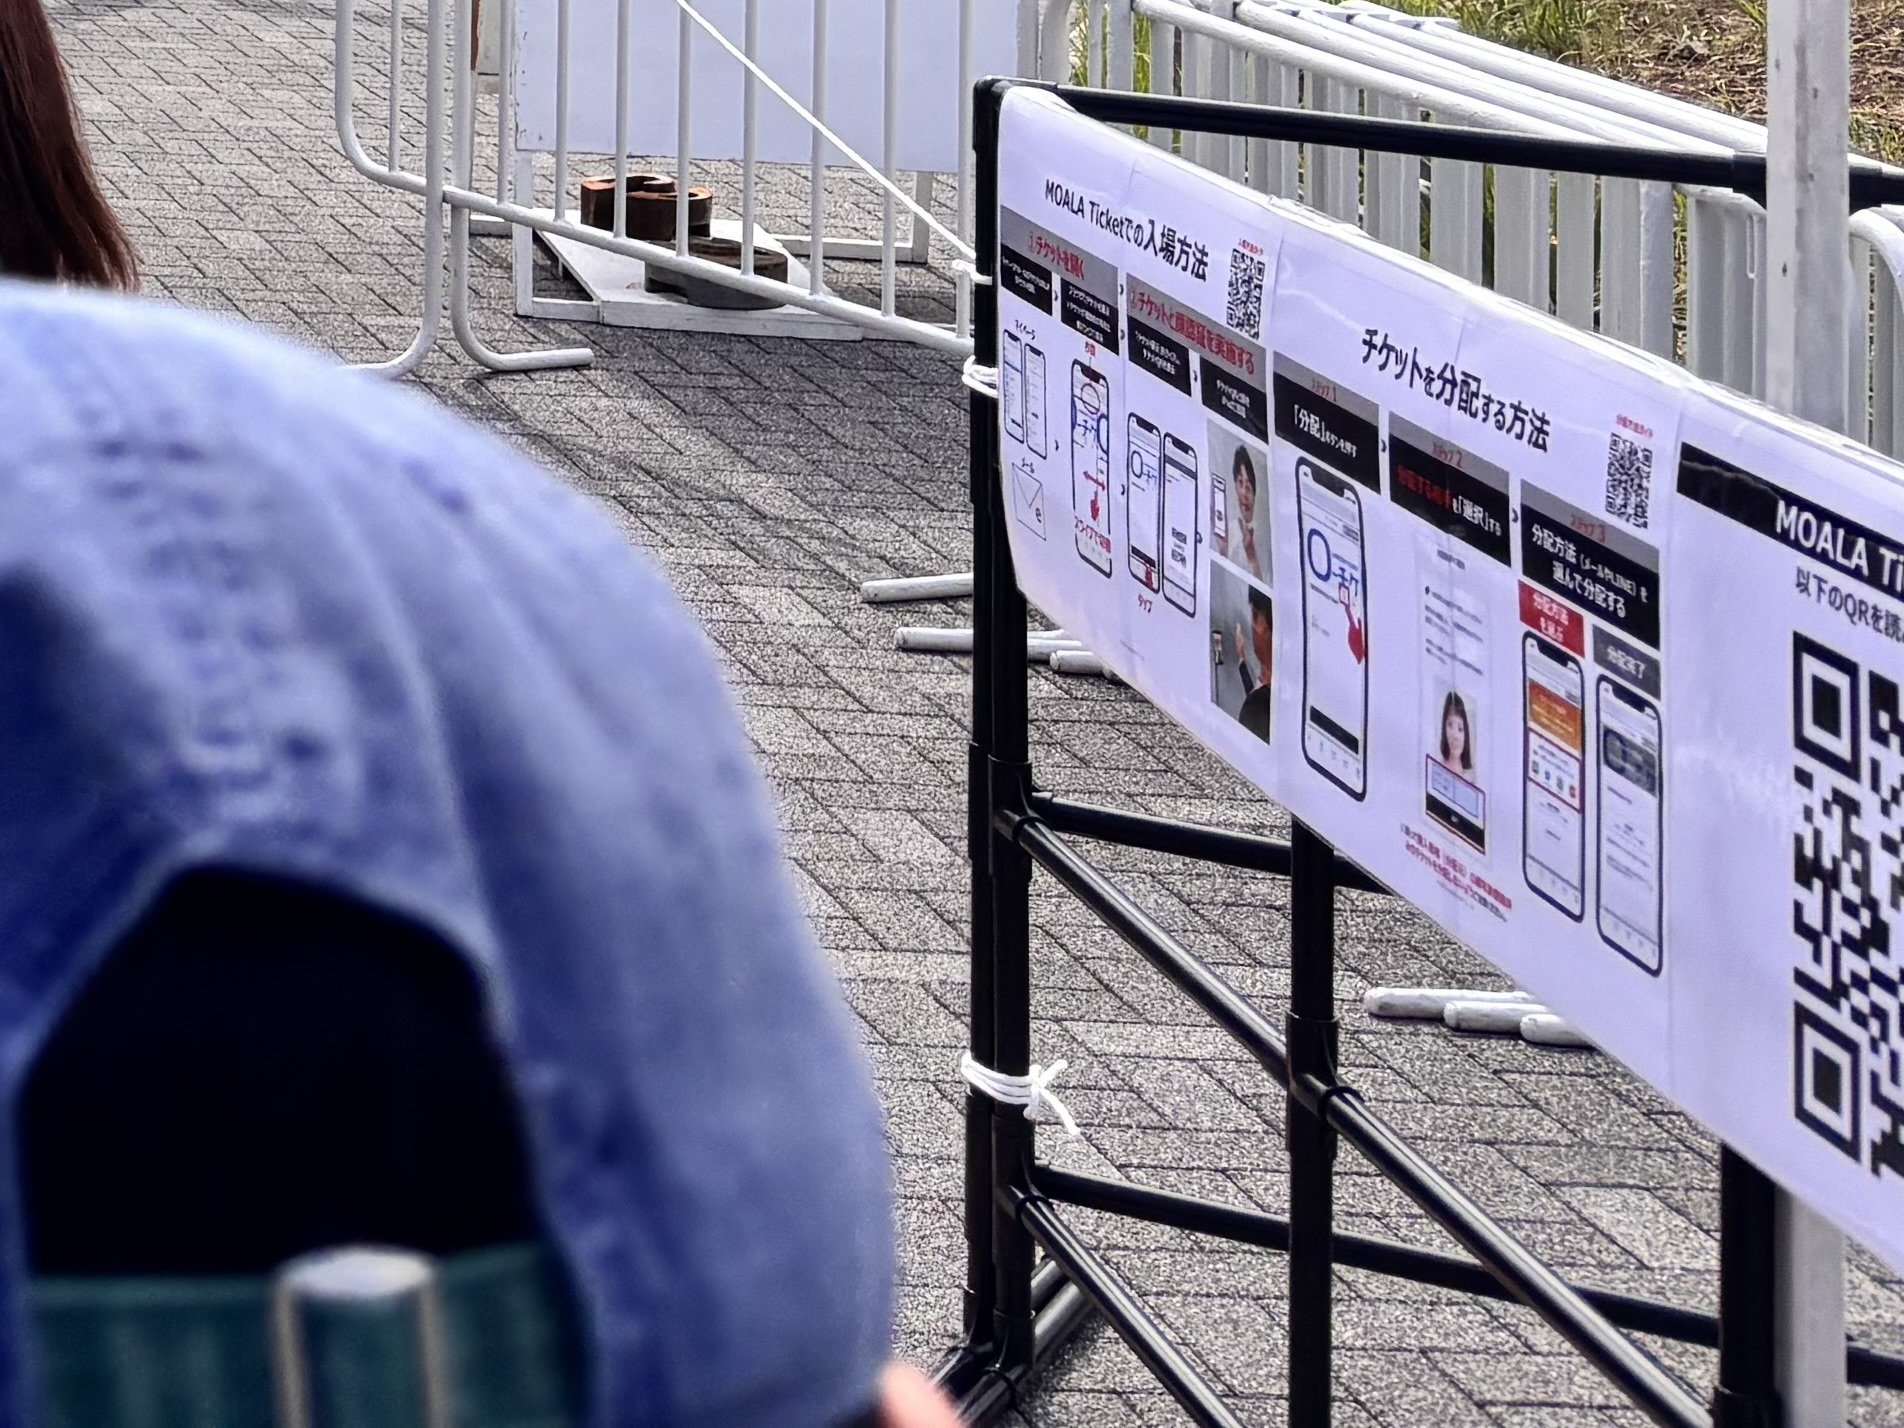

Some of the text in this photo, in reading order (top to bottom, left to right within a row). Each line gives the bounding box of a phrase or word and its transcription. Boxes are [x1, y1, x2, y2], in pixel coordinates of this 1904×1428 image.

[1045, 178, 1086, 220] MOALA
[1089, 198, 1210, 283] Ticketでの入場方法
[1362, 327, 1552, 454] チケットを分配する方法
[1775, 499, 1870, 577] MOALA
[1795, 565, 1904, 644] 以下のQRを読
